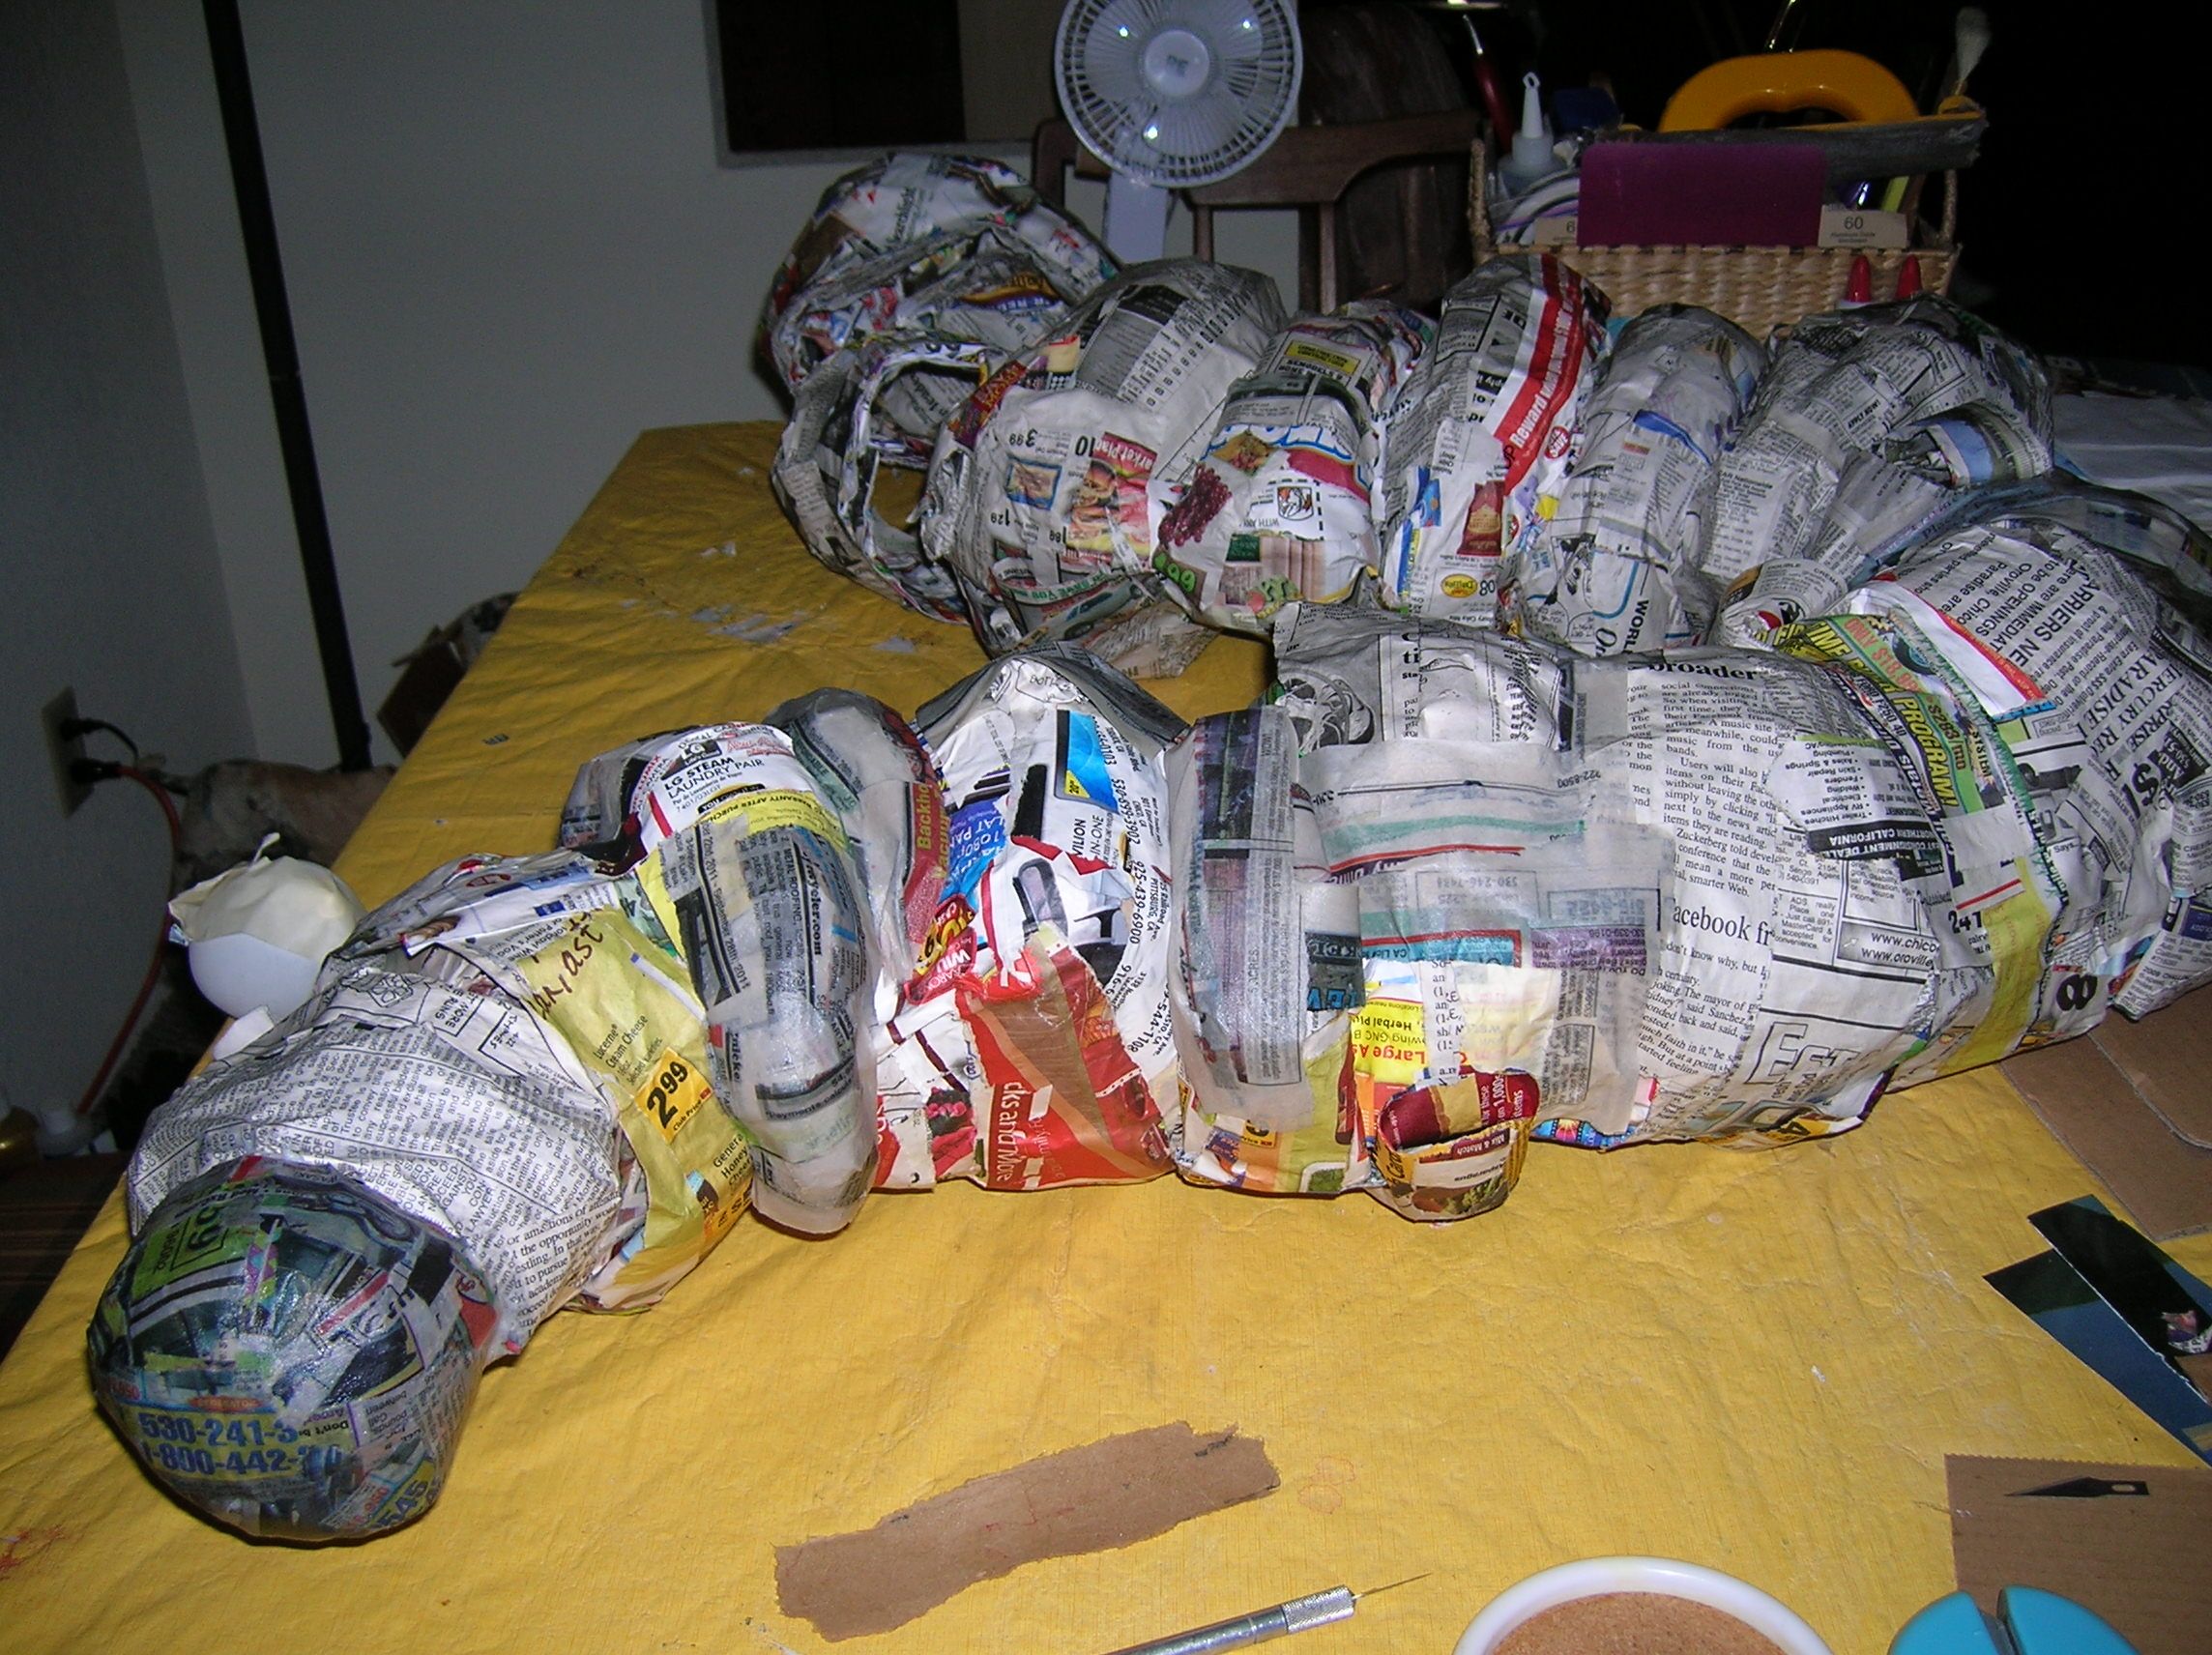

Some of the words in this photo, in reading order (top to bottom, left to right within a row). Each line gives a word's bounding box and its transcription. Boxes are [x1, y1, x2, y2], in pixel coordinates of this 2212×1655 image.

[1843, 216, 1864, 230] 60
[1960, 561, 2007, 595] Paradise
[1987, 563, 2032, 596] Oroville,
[1957, 596, 1992, 625] Chico
[1976, 582, 2036, 637] OPENINGS
[1721, 720, 1751, 729] music
[1667, 736, 1697, 745] music
[1707, 740, 1732, 750] from
[1742, 744, 1759, 754] the
[1750, 735, 1777, 745] could
[1667, 745, 1698, 757] bands.
[664, 774, 683, 790] LG
[686, 756, 735, 778] STEAM
[1679, 757, 1708, 769] Users
[1714, 763, 1733, 772] will
[1739, 768, 1758, 778] also
[1786, 761, 1820, 770] Springs
[667, 765, 731, 799] LAUNDRY
[735, 758, 766, 770] PAIR
[1666, 768, 1693, 778] items
[1722, 775, 1744, 787] their
[1665, 779, 1704, 790] without
[1708, 783, 1741, 801] leaving
[1744, 794, 1757, 806] the
[1822, 794, 1861, 804] Electrical
[1827, 784, 1860, 793] Welding
[1664, 803, 1686, 812] next
[1708, 810, 1722, 821] the
[1728, 818, 1750, 829] news
[1665, 791, 1700, 803] simply
[1705, 796, 1717, 807] by
[1723, 801, 1759, 821] clicking
[1800, 804, 1848, 815] Appliances
[1664, 814, 1689, 828] items
[1693, 820, 1710, 834] they
[1714, 827, 1728, 837] are
[1731, 831, 1767, 850] reading.
[1676, 828, 1728, 852] Zuckerberg
[1730, 843, 1747, 857] told
[1829, 829, 1895, 846] CALIFORNIA
[1677, 843, 1727, 863] conference
[1732, 857, 1750, 872] that
[1756, 862, 1771, 876] the
[1685, 858, 1712, 873] mean
[1730, 871, 1754, 886] more
[1689, 874, 1725, 890] smarter
[1729, 880, 1750, 897] Web.
[1790, 905, 1810, 915] Place
[1781, 920, 1822, 933] MasterCard
[1692, 948, 1714, 963] know
[1741, 963, 1758, 974] but
[1686, 1002, 1704, 1014] said
[1703, 994, 1732, 1009] mayor
[1733, 1001, 1744, 1011] of
[622, 1014, 650, 1045] Cheese
[1373, 1018, 1412, 1031] Herbal
[1700, 1019, 1716, 1032] and
[1365, 1032, 1389, 1043] GNC
[1657, 1039, 1674, 1056] But
[1373, 1046, 1426, 1064] Large
[359, 1089, 378, 1121] convey
[395, 1103, 407, 1121] and
[434, 1099, 446, 1119] paid
[673, 1115, 687, 1132] Club
[684, 1098, 703, 1119] Price
[340, 1099, 362, 1133] Trustee
[410, 1132, 420, 1148] the
[421, 1092, 436, 1119] return
[364, 1120, 377, 1140] any
[504, 1142, 516, 1155] the
[1455, 1141, 1483, 1156] Match
[486, 1147, 502, 1174] aside
[510, 1155, 521, 1171] the
[515, 1151, 537, 1187] entitled
[532, 1162, 556, 1199] deposit
[553, 1139, 566, 1159] paid
[462, 1173, 478, 1195] YOU
[524, 1163, 541, 1193] return
[540, 1155, 570, 1203] Purchaser
[520, 1242, 538, 1255] the
[525, 1274, 537, 1287] to
[538, 1257, 568, 1282] pursue
